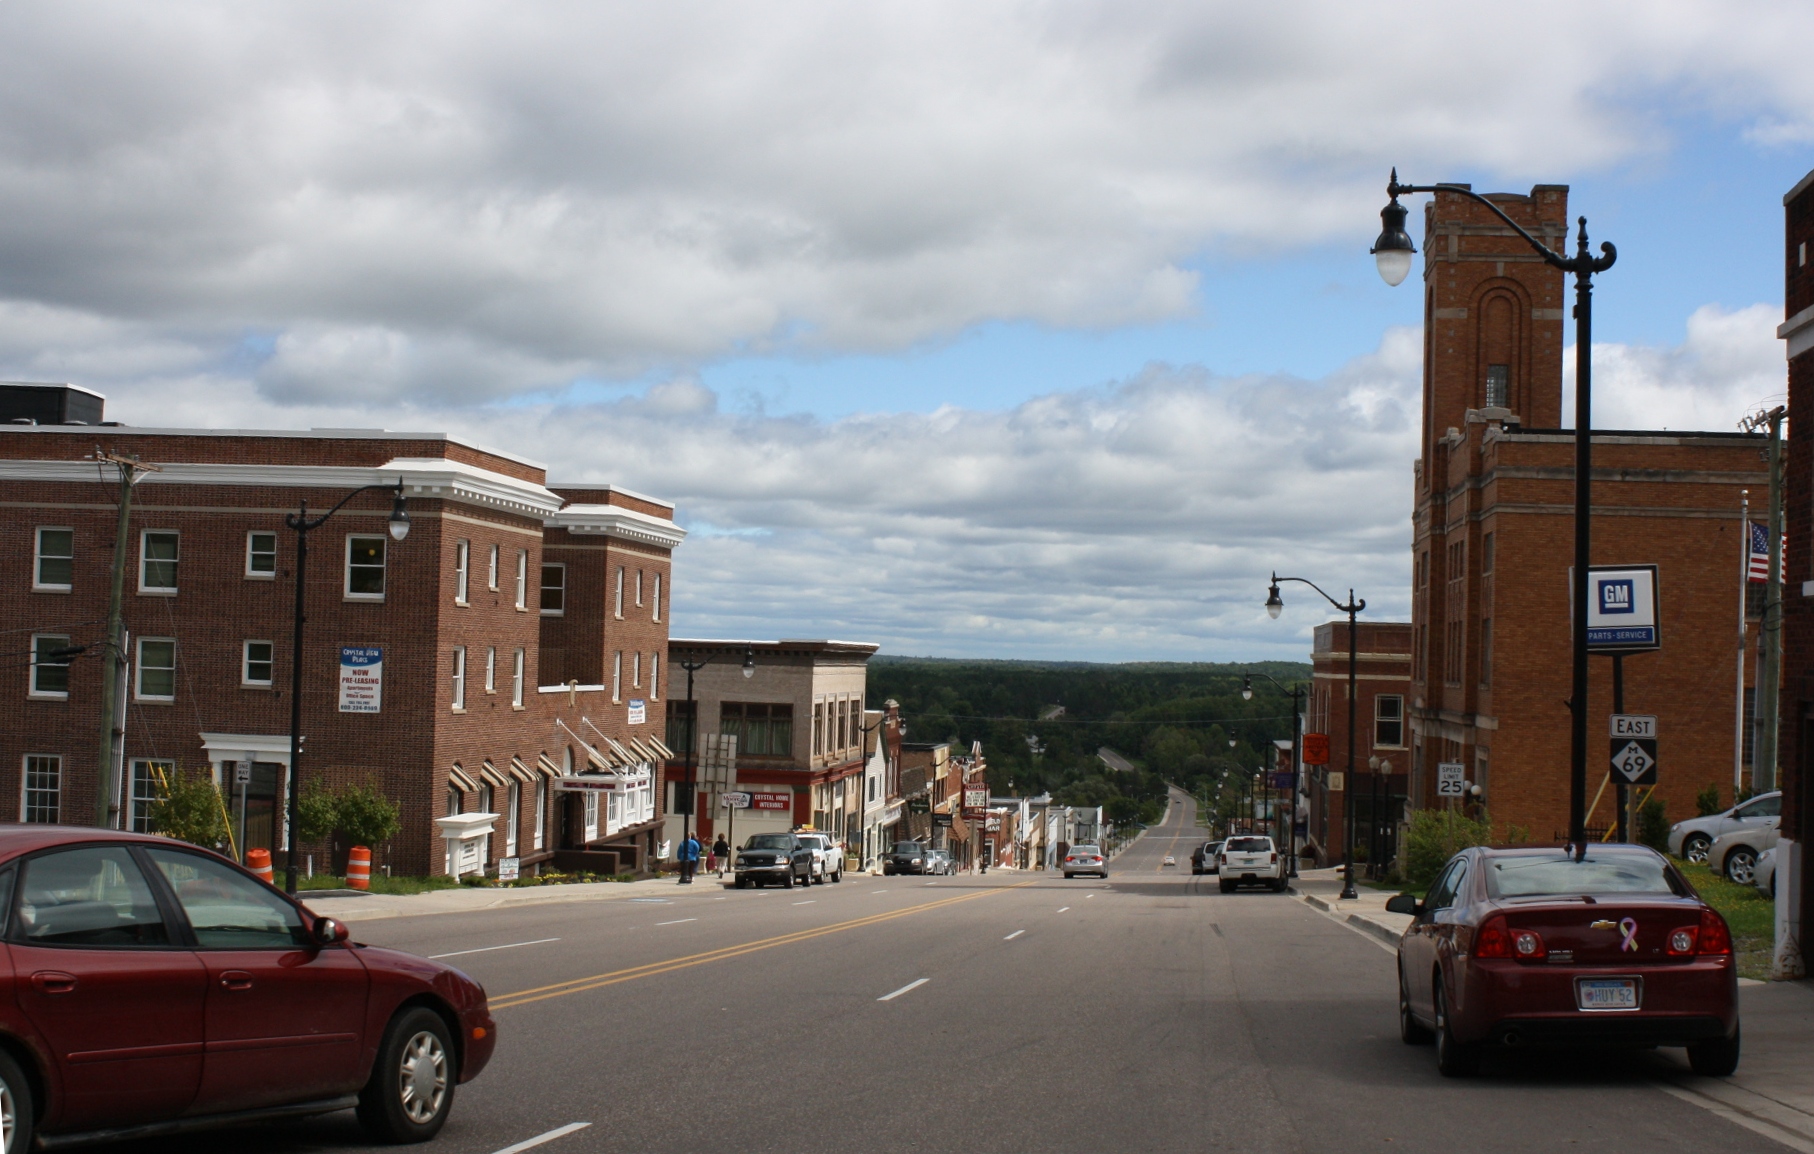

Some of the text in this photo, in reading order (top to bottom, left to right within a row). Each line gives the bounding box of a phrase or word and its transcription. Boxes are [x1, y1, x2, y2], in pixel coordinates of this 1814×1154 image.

[1604, 585, 1629, 603] GM
[342, 677, 379, 685] PRE-LEASING
[1617, 719, 1650, 734] EAST
[1627, 746, 1639, 754] M
[1441, 766, 1462, 774] SPEED
[1622, 756, 1646, 773] 69
[1440, 780, 1462, 793] 25
[1618, 988, 1632, 1002] 52
